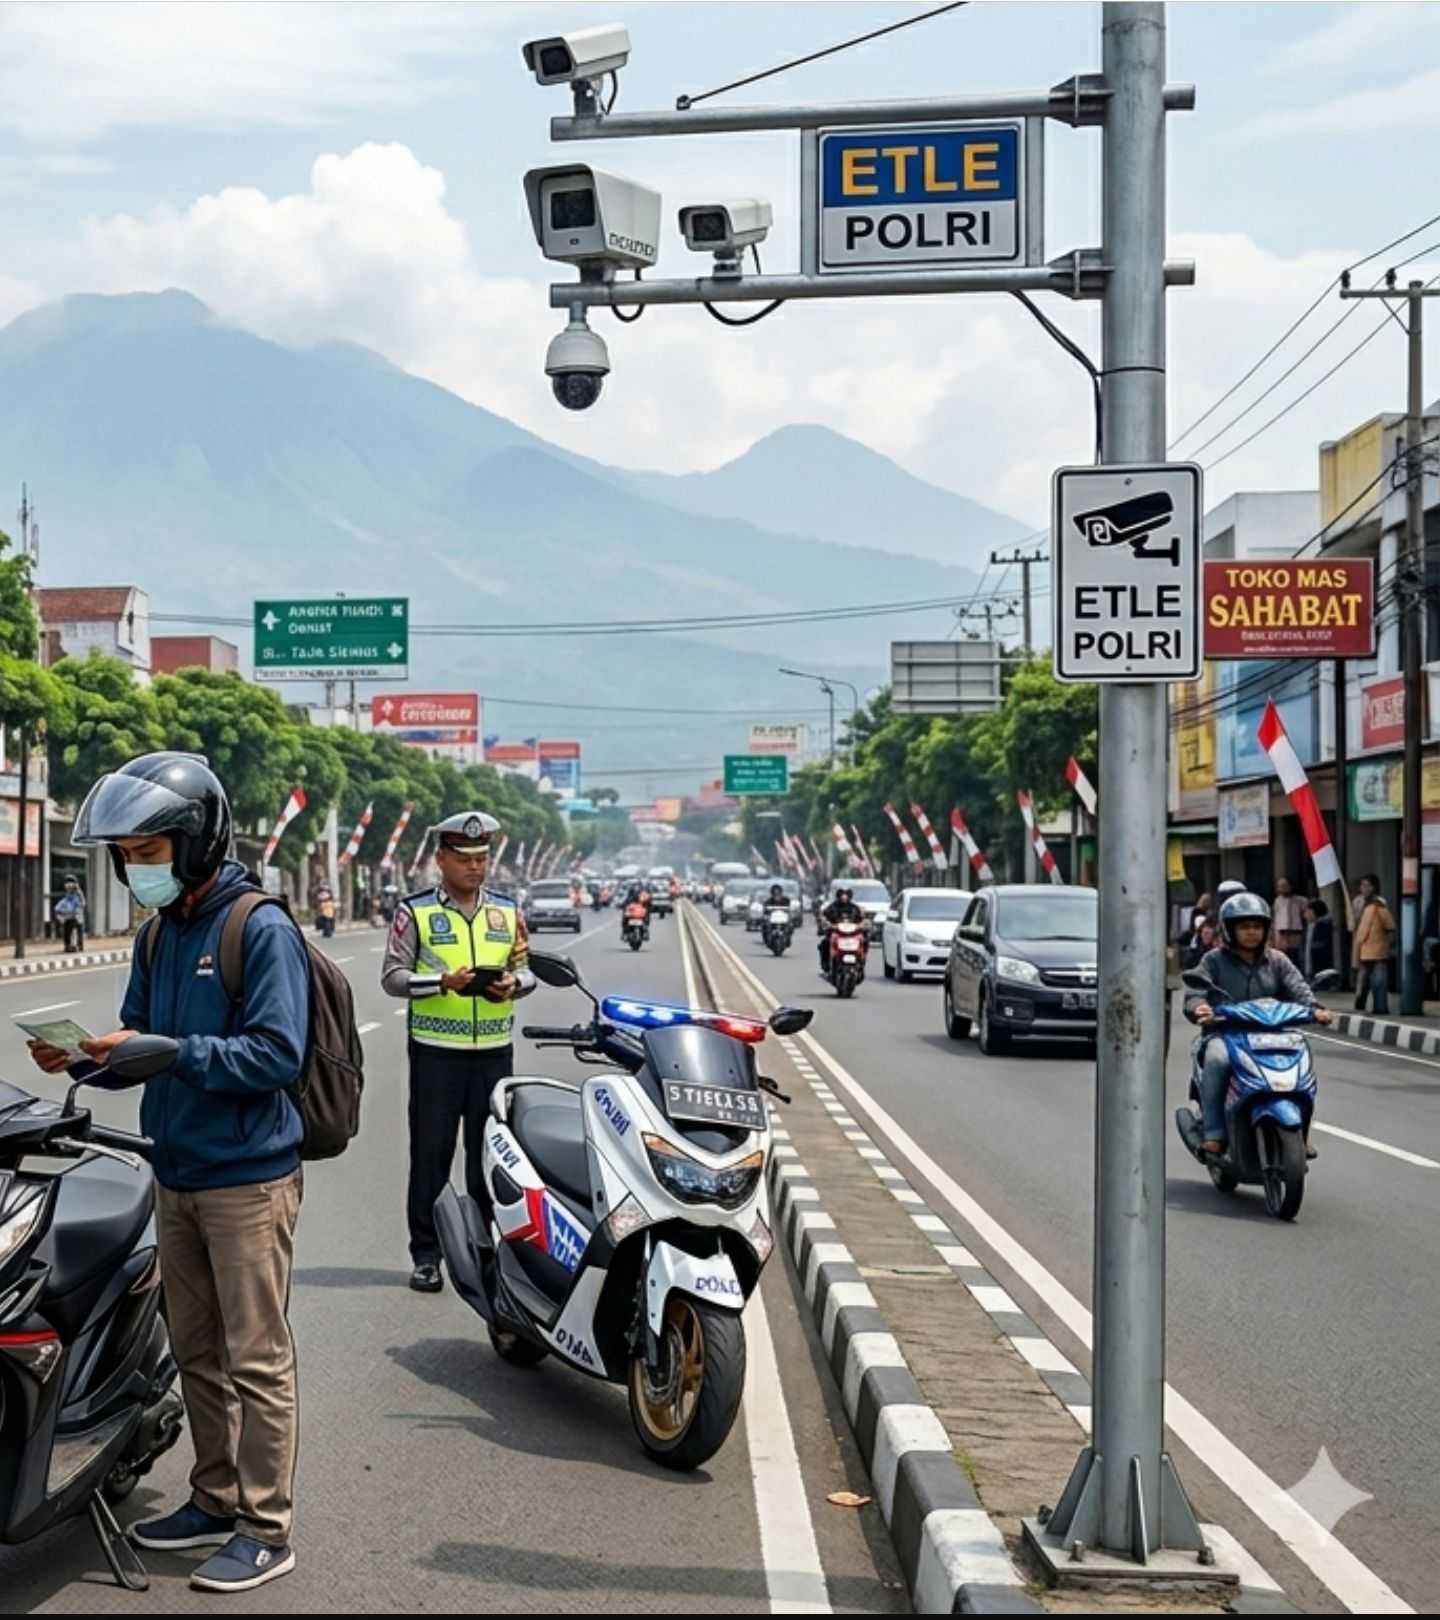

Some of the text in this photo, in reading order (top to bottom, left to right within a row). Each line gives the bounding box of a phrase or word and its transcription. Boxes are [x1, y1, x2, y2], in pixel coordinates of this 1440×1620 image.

[842, 143, 1000, 196] ETLE
[846, 211, 990, 250] POLRI
[1226, 569, 1348, 588] TOKO MAS
[1075, 585, 1181, 619] ETLE
[1208, 594, 1363, 628] SAHABAT
[1074, 629, 1181, 659] POLRI
